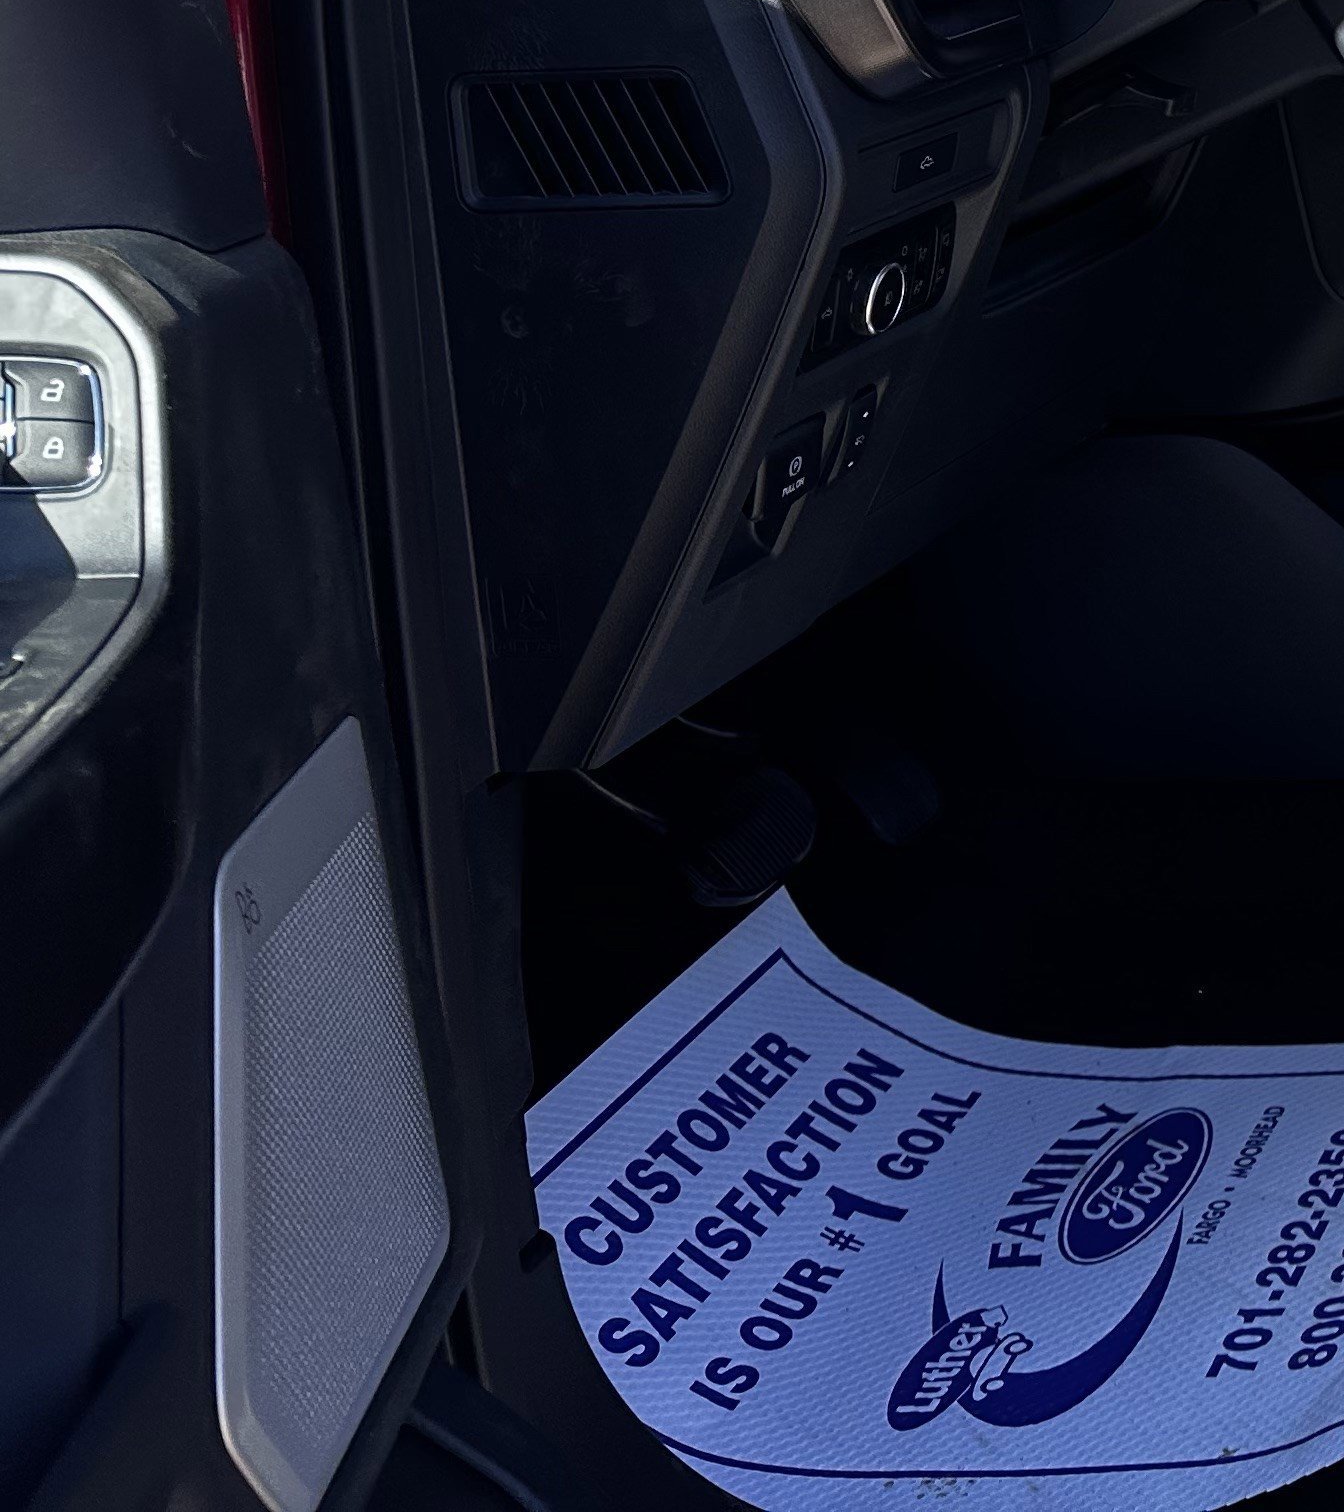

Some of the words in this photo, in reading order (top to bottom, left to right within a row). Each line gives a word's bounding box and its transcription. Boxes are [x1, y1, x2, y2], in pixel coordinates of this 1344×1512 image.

[563, 1031, 811, 1266] CUSTOMER
[597, 1047, 905, 1367] SATISFACTION
[988, 1103, 1138, 1270] FAMILY
[1081, 1138, 1190, 1230] Ford
[1187, 1199, 1232, 1245] FARGO
[1233, 1105, 1286, 1179] MOORHEAD
[689, 1356, 760, 1411] IS
[739, 1258, 845, 1351] OUR
[877, 1088, 982, 1181] GOAL
[896, 1321, 988, 1415] Luther
